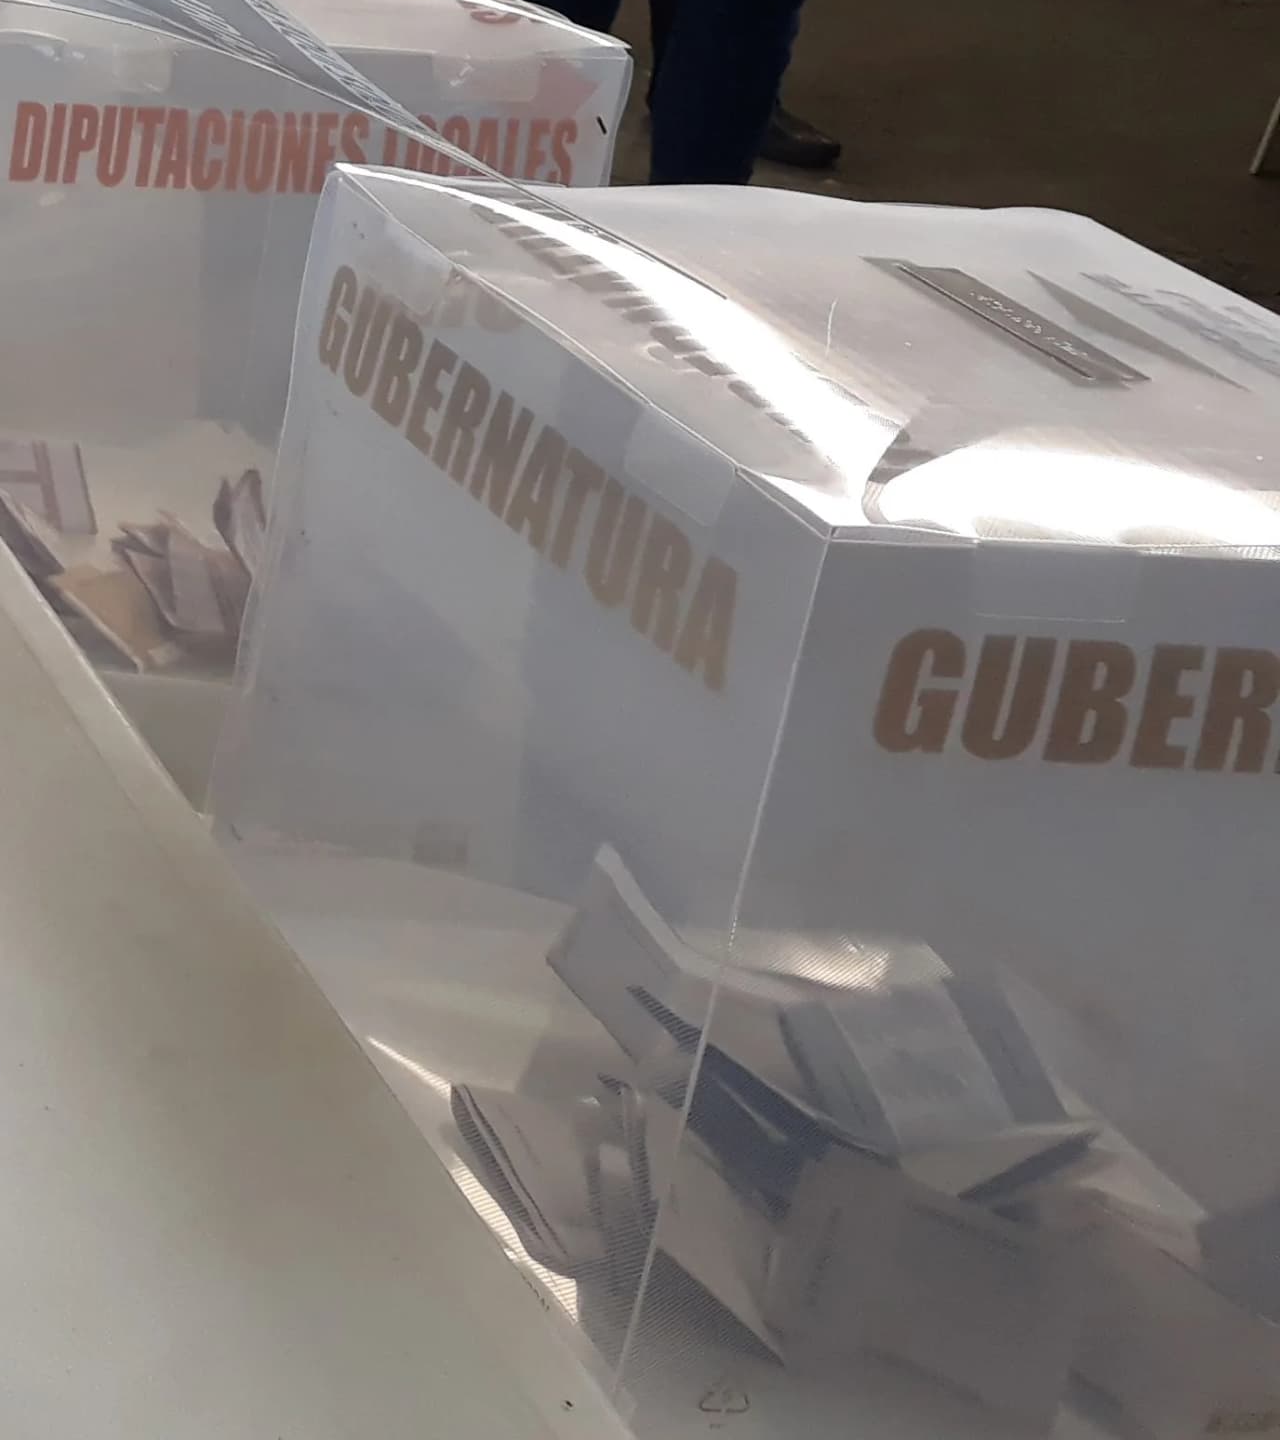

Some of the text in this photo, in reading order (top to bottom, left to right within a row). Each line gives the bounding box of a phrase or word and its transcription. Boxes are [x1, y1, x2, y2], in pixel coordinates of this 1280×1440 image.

[7, 99, 372, 196] DIPUTACIONES
[316, 264, 740, 696] GUBERNATURA
[872, 626, 1280, 776] GUBER
